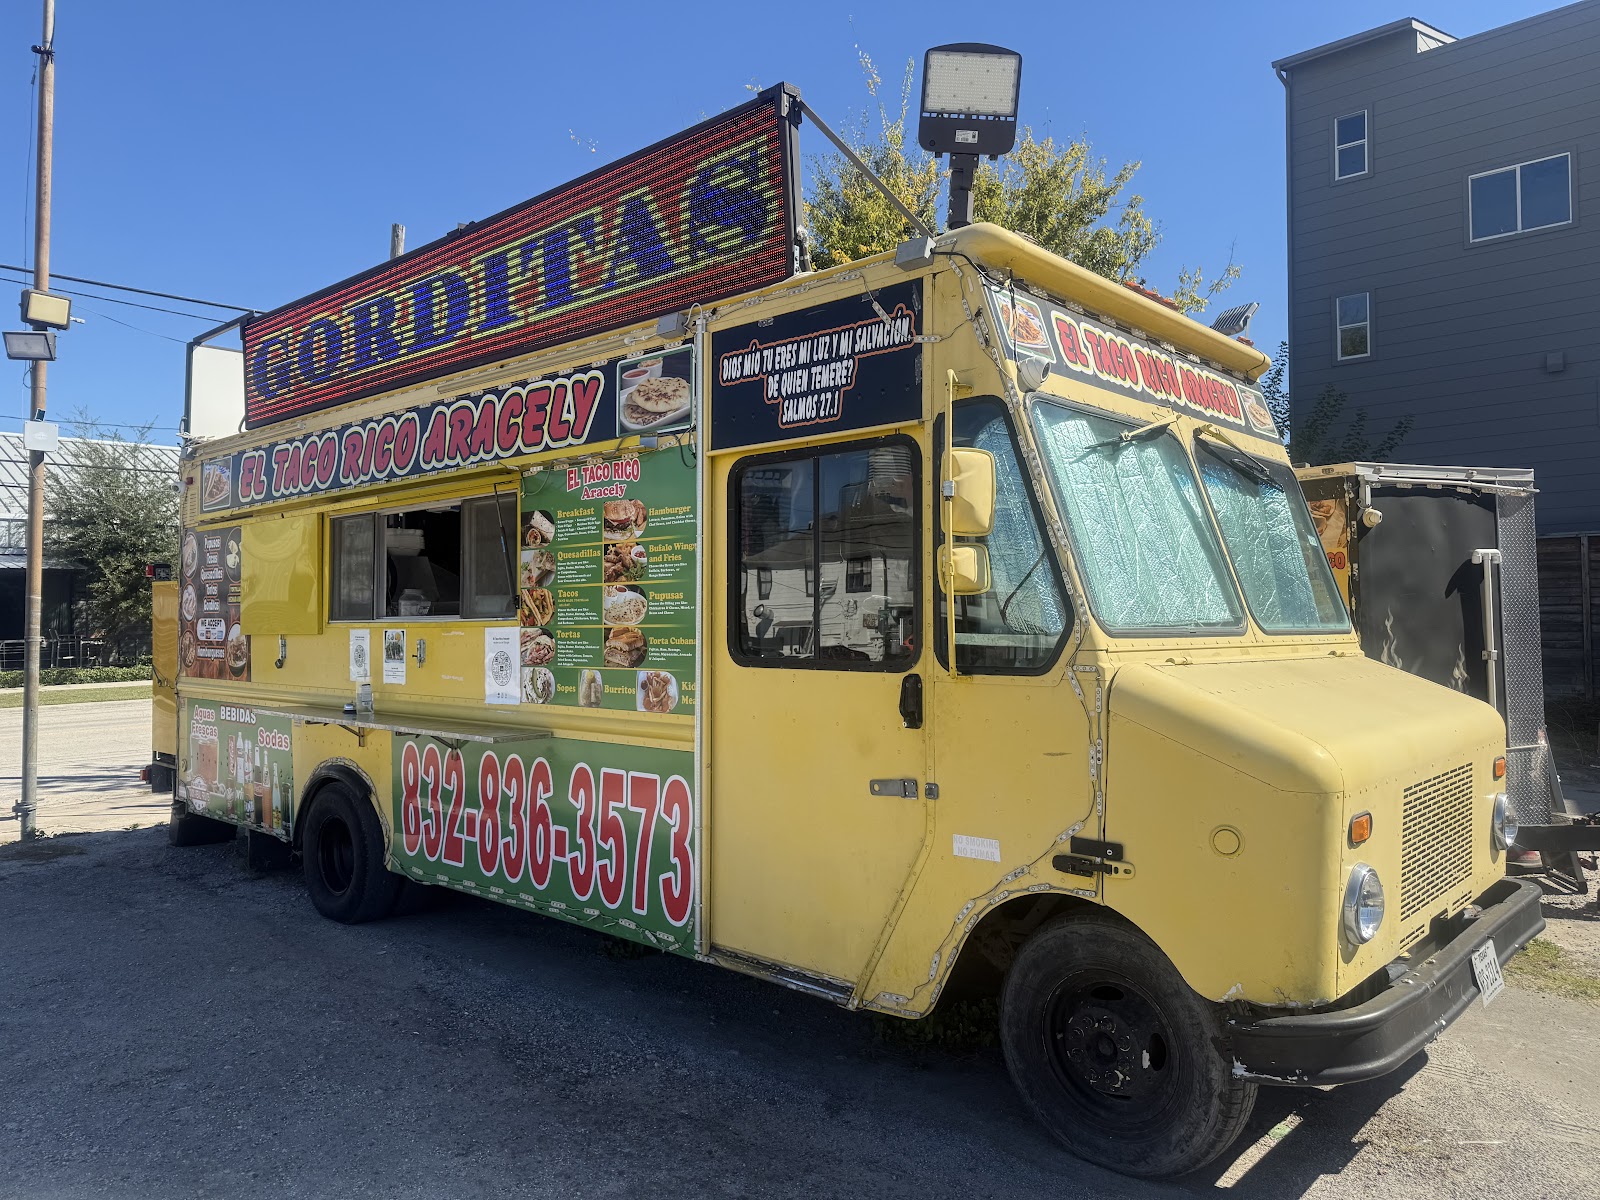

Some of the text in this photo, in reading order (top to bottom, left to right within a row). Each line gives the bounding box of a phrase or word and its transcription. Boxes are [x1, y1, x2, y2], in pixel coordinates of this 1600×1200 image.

[723, 356, 742, 381] DIOS
[744, 346, 760, 376] MÍO
[762, 349, 773, 373] TU
[775, 345, 796, 371] ERES
[799, 341, 810, 365] MI
[813, 338, 829, 362] LUZ
[832, 335, 838, 358] Y
[840, 330, 853, 357] MI
[1053, 314, 1244, 423] EL TACO RICO ARACELY
[768, 376, 779, 398] DE
[781, 369, 807, 396] QUIEN
[783, 390, 839, 423] SALMOS 27.1
[240, 372, 603, 499] EL TACO RICO ARACELY
[567, 458, 640, 492] EL TACO RICO
[581, 482, 627, 500] Aracely
[557, 507, 594, 518] Breakfast
[649, 506, 691, 516] Hamburger
[557, 549, 600, 560] Quesadillas
[649, 543, 672, 552] Bufalo
[649, 553, 682, 562] and Fries
[557, 589, 579, 597] Tacos
[649, 591, 683, 601] Pupusas
[207, 619, 222, 627] ACCEPT
[556, 630, 581, 638] Tortas
[649, 637, 669, 645] Torta
[557, 683, 576, 693] Sopes
[604, 684, 636, 695] Burritos
[194, 705, 215, 722] Aguas
[220, 705, 256, 724] BEBIDAS
[191, 721, 218, 738] Frescas
[258, 727, 290, 751] Sodas
[401, 740, 694, 927] 832-836-3573
[953, 834, 999, 850] NO SMOKING
[957, 846, 995, 860] NO FUMAR
